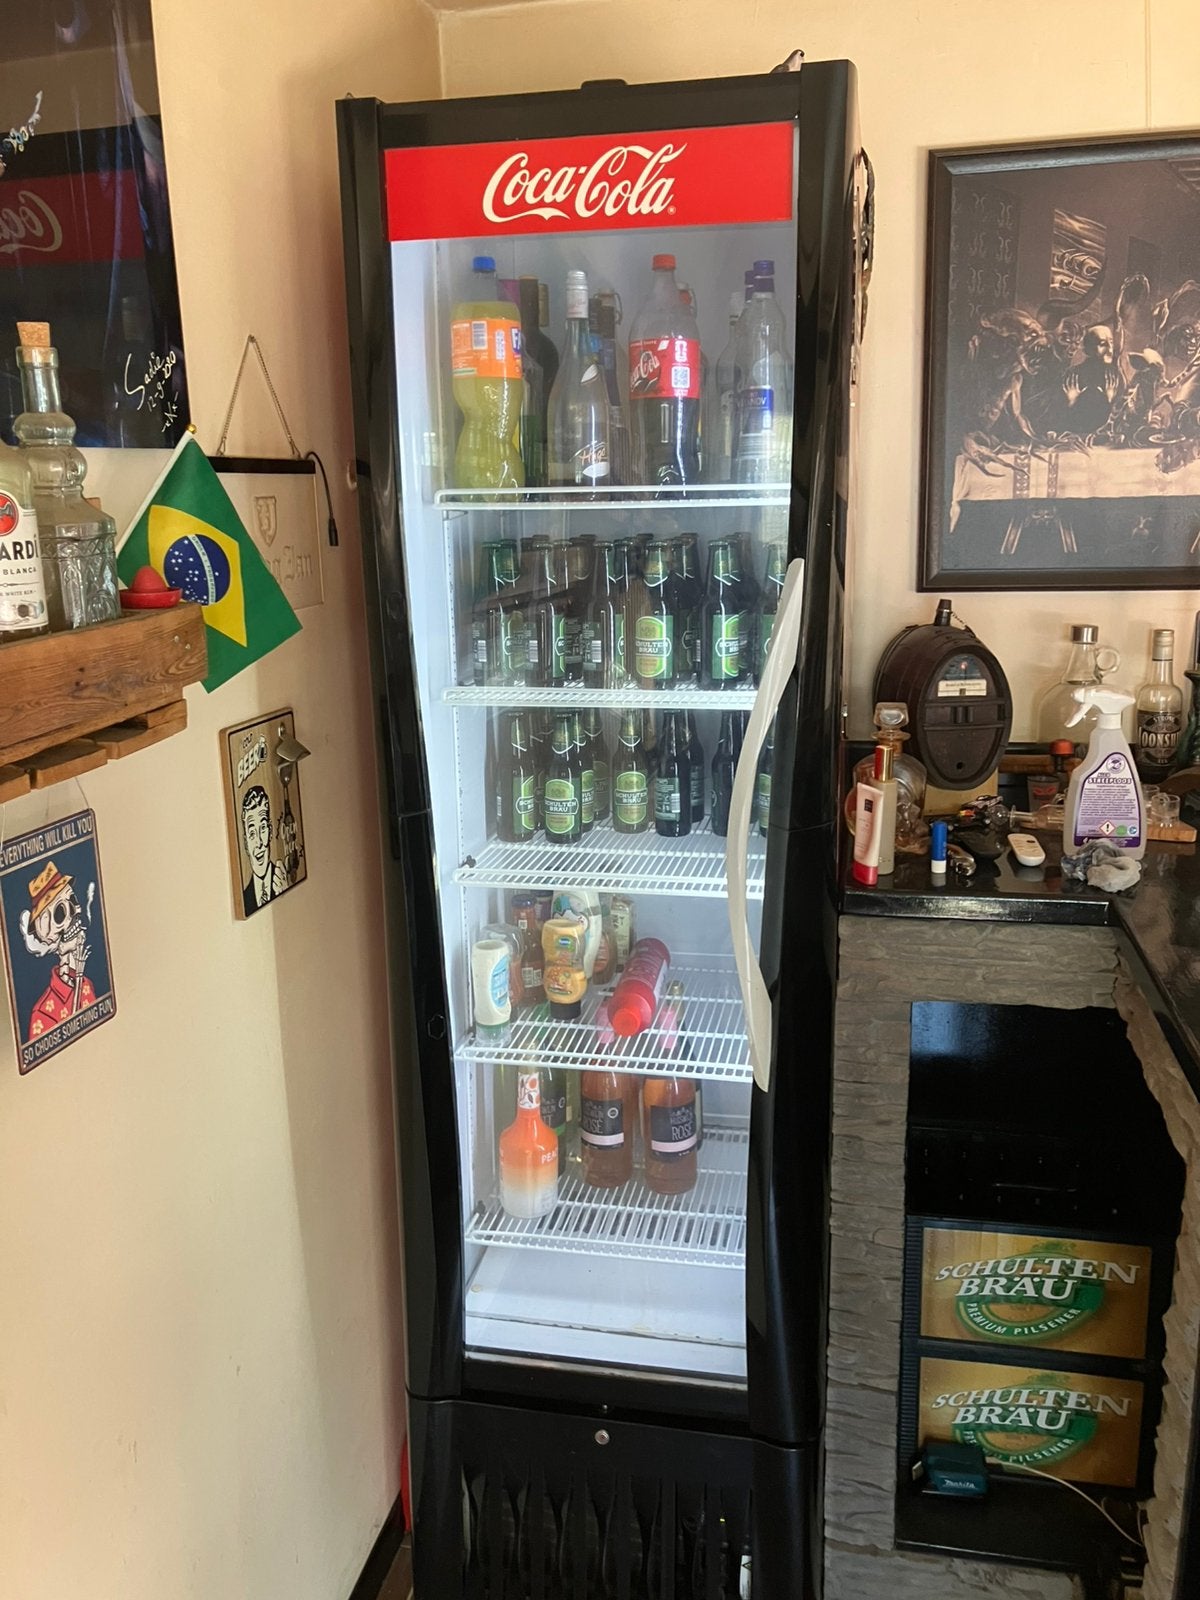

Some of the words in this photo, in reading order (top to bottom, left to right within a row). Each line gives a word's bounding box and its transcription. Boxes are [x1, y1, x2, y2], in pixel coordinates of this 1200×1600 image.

[483, 142, 687, 222] Coca-Cola
[3, 567, 37, 575] BLANCA
[0, 835, 45, 868] EVERYTHING
[44, 828, 61, 849] WILL
[62, 822, 77, 842] KILL
[77, 816, 93, 834] YOU
[23, 1047, 34, 1064] SO
[35, 1029, 62, 1056] CHOOSE
[62, 1006, 98, 1039] SOMETHING
[99, 998, 113, 1016] FUN
[935, 1257, 1141, 1285] SCHULTEN
[955, 1276, 1078, 1300] BRÄU
[966, 1301, 1007, 1335] PREMIUM
[1014, 1308, 1081, 1335] PILSENER
[931, 1388, 1133, 1417] SCHULTEN
[952, 1406, 1071, 1431] BRÄU
[1009, 1437, 1076, 1464] PILSENER
